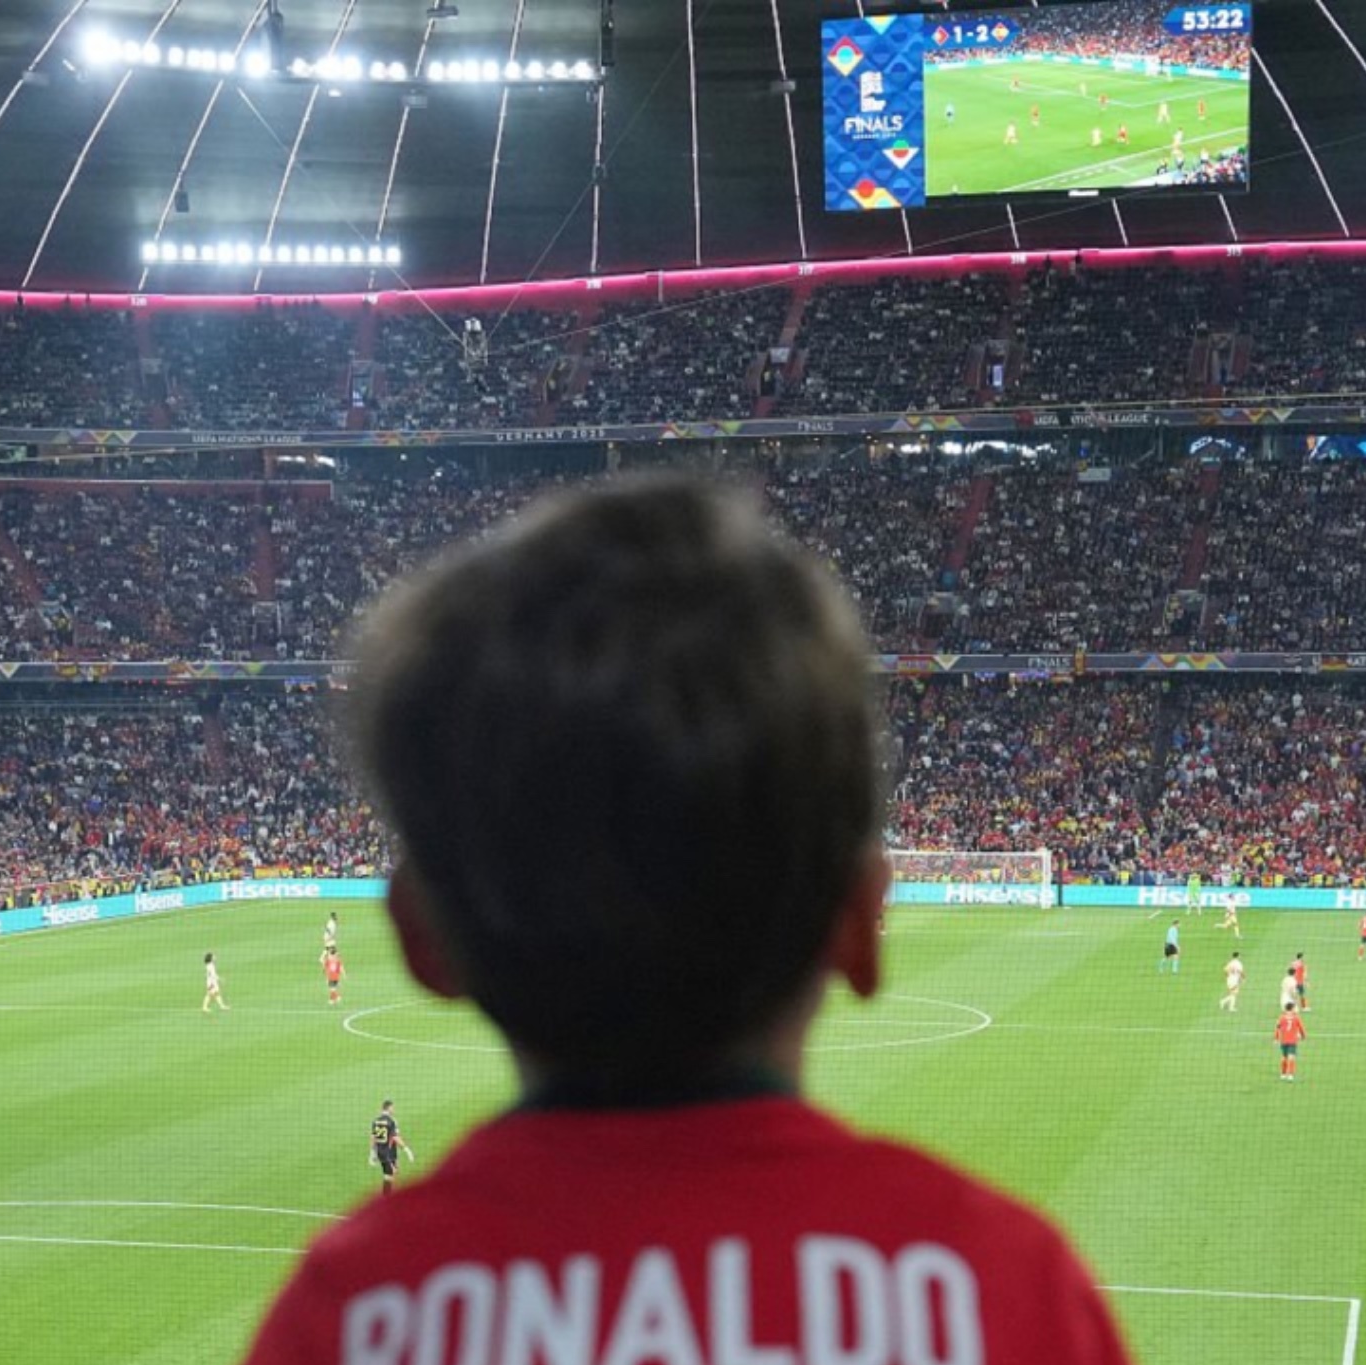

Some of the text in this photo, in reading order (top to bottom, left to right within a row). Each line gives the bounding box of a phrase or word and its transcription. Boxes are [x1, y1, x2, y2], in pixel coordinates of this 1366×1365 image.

[1182, 9, 1243, 31] 53:22
[953, 25, 963, 43] 1
[976, 24, 989, 42] 2
[844, 115, 903, 135] FINALS
[221, 880, 320, 899] Hisense
[135, 892, 183, 913] Hisense
[43, 904, 98, 925] Hisense
